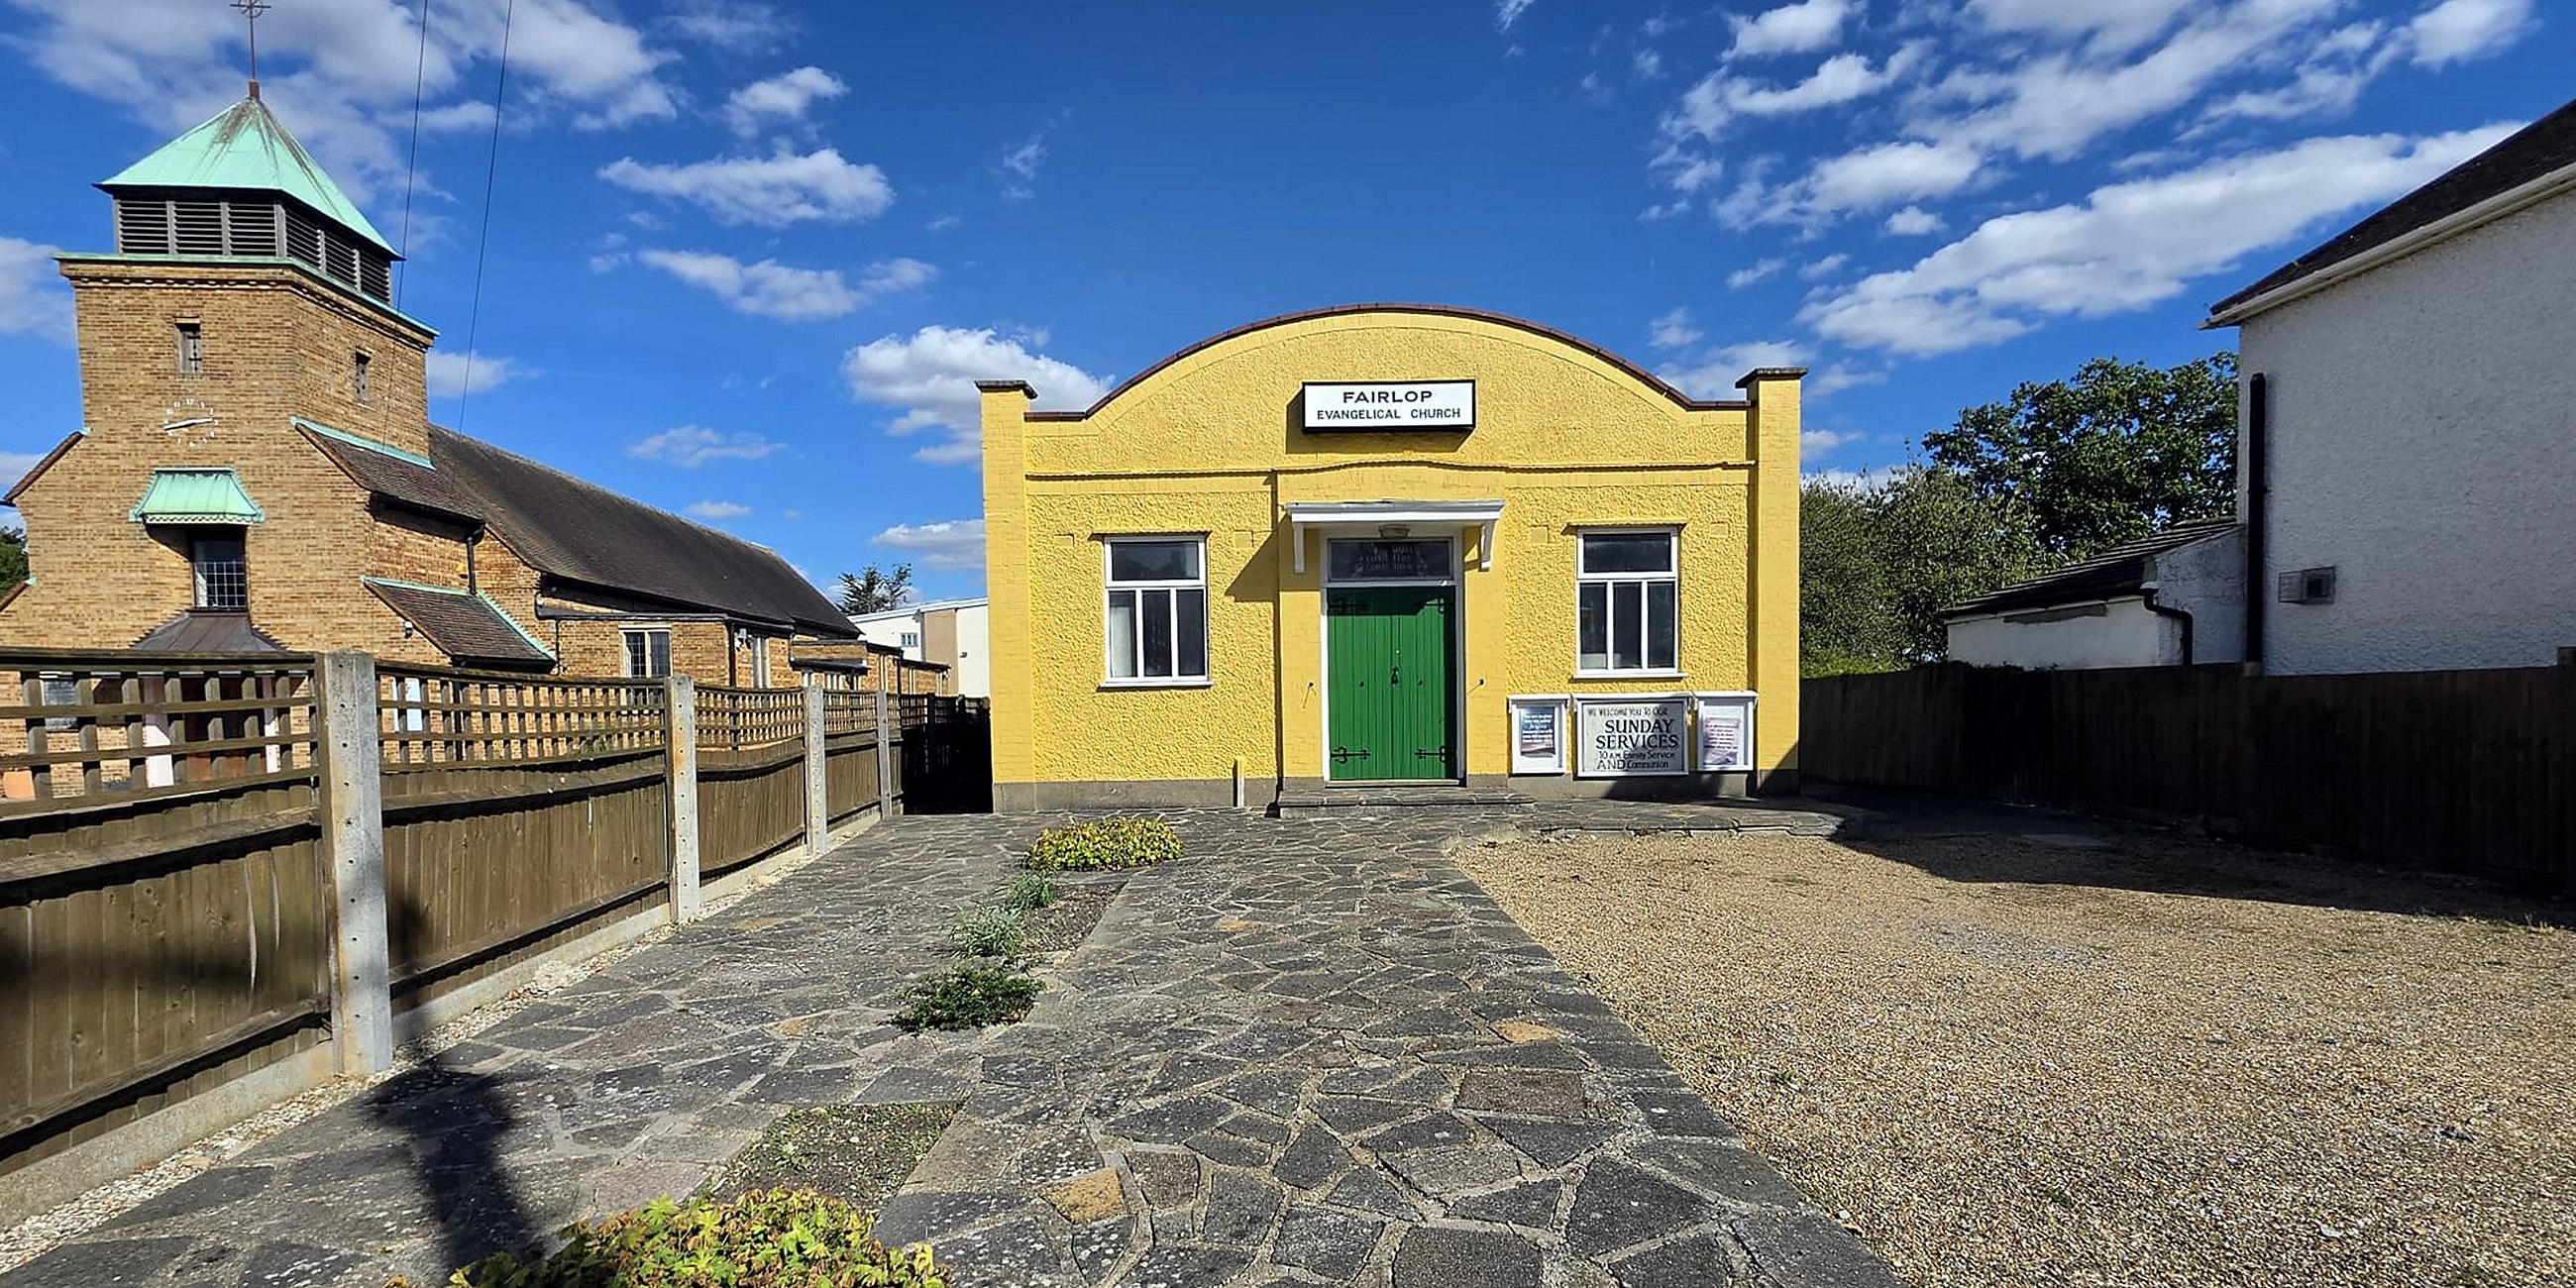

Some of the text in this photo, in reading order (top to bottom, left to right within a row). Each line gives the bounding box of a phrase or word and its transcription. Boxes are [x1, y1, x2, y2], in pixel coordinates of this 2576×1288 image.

[1342, 390, 1433, 403] FAIRLOP
[1317, 408, 1460, 420] EVANGELICAL CHURCH
[1605, 719, 1674, 733] SUNDAY
[1596, 734, 1678, 749] SERVICES
[1597, 760, 1626, 769] AND
